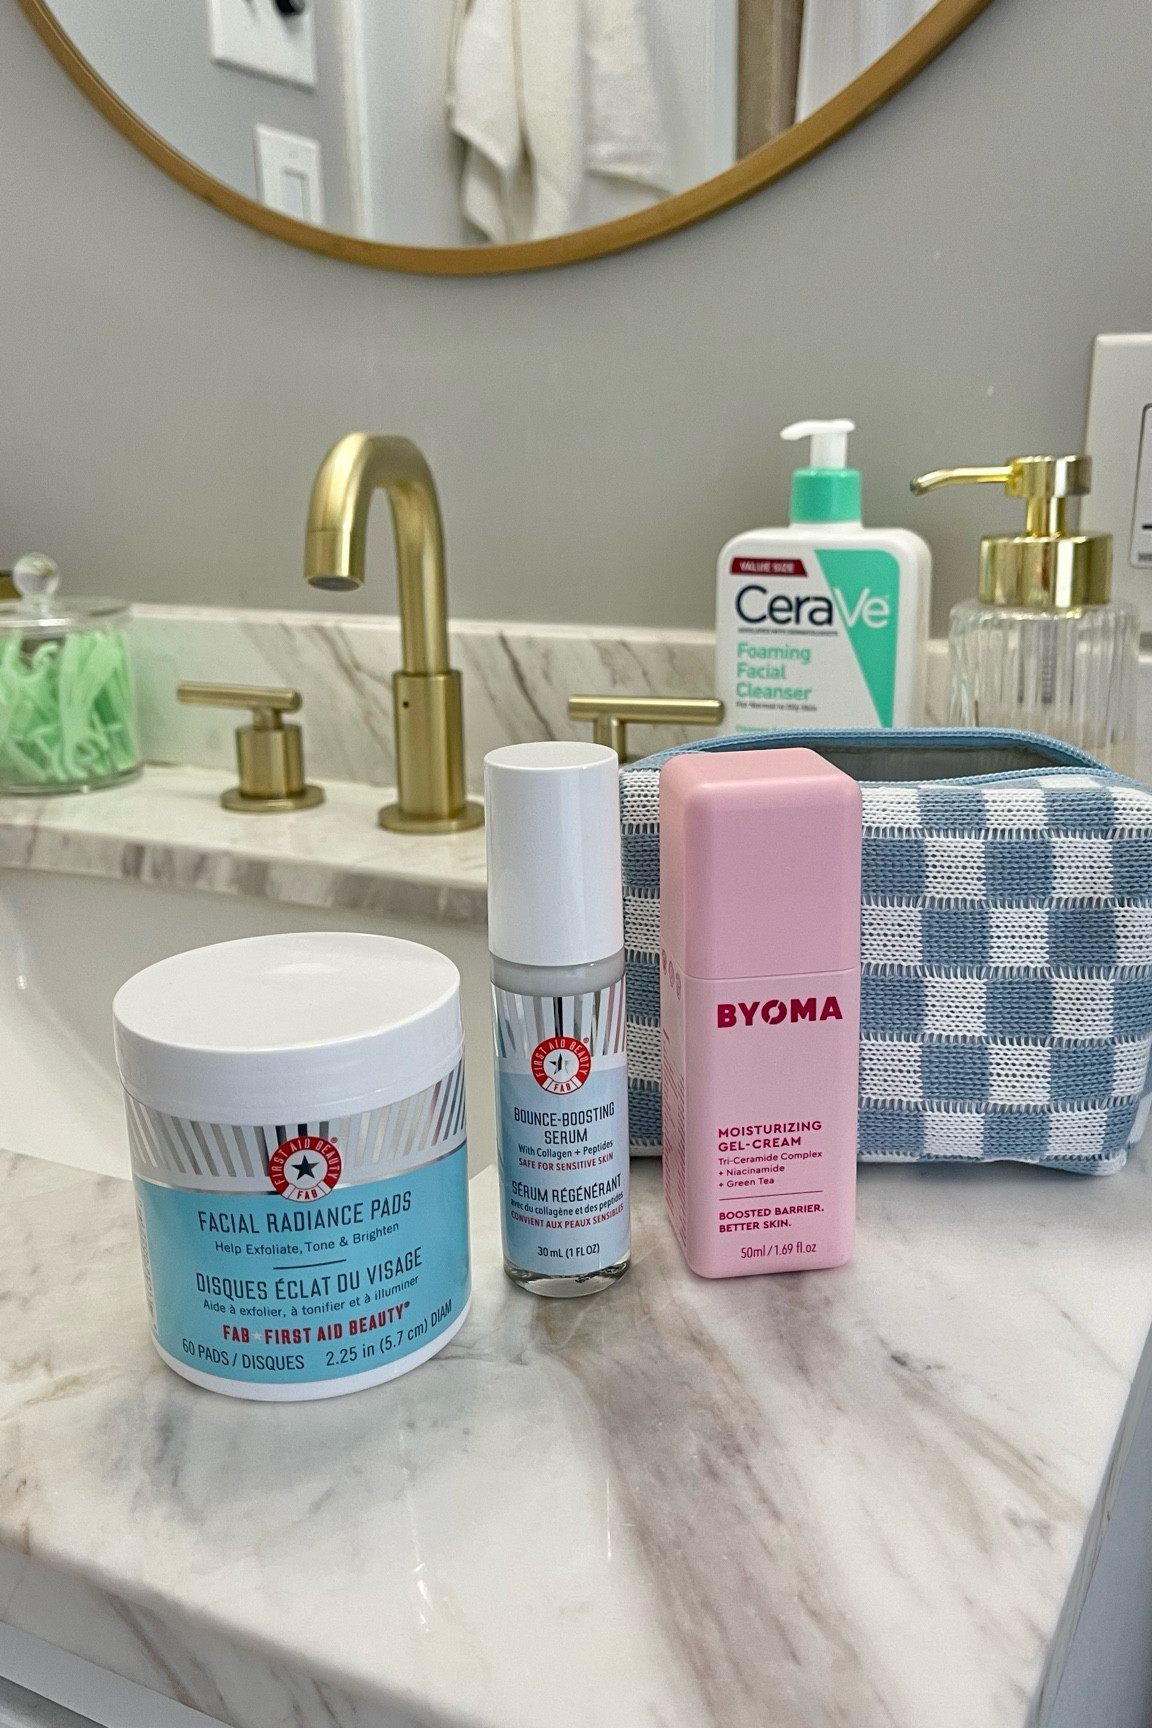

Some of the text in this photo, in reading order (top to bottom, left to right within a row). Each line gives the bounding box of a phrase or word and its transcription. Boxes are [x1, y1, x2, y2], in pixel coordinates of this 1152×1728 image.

[735, 584, 890, 629] CeraVe
[737, 642, 811, 665] Foaming
[736, 661, 786, 680] Facial
[736, 682, 812, 701] Cleanser
[717, 996, 843, 1028] BYOMA
[533, 1039, 589, 1078] FIRST AID BEAUTY
[553, 1082, 571, 1092] FAB
[514, 1101, 615, 1127] BOUNCE-BOOSTING
[544, 1128, 588, 1145] SERUM
[718, 1121, 822, 1138] MOISTURIZING
[518, 1143, 536, 1156] With
[537, 1148, 572, 1160] Collagen
[583, 1139, 614, 1156] Peptides
[718, 1136, 802, 1152] GEL-CREAM
[271, 1138, 340, 1186] FIRST AID BEAUTY
[519, 1152, 614, 1171] SAFE FOR SENSITIVE SKIN
[718, 1150, 823, 1166] Tri-Ceramide Complex
[726, 1164, 785, 1177] Niacinamide
[512, 1173, 621, 1203] SÉRUM RÉGÉNÉRANT
[726, 1179, 756, 1188] Green
[758, 1177, 775, 1185] Tea
[296, 1188, 318, 1200] FAB
[511, 1191, 624, 1218] avec du collagène et des peptides
[198, 1191, 411, 1233] FACIAL RADIANCE PADS
[511, 1203, 624, 1229] CONVIENT AUX PEAUX SENSIBLES
[719, 1204, 825, 1220] BOOSTED BARRIER.
[719, 1219, 792, 1233] BETTER SKIN.
[215, 1223, 399, 1255] Help Exfoliate, Tone & Brighten
[537, 1243, 600, 1260] 30 mL (1 FL OZ)
[196, 1246, 422, 1301] DISQUES ÉCLAT DU VISAGE
[203, 1275, 419, 1318] Aide à exfolier, à tonifier et à illuminer
[223, 1324, 250, 1343] FAB
[264, 1328, 312, 1345] FIRST
[317, 1323, 343, 1342] AID
[326, 1298, 452, 1367] 2.25 in (5.7 cm) DIAM
[182, 1338, 305, 1371] 60 PADS / DISQUES
